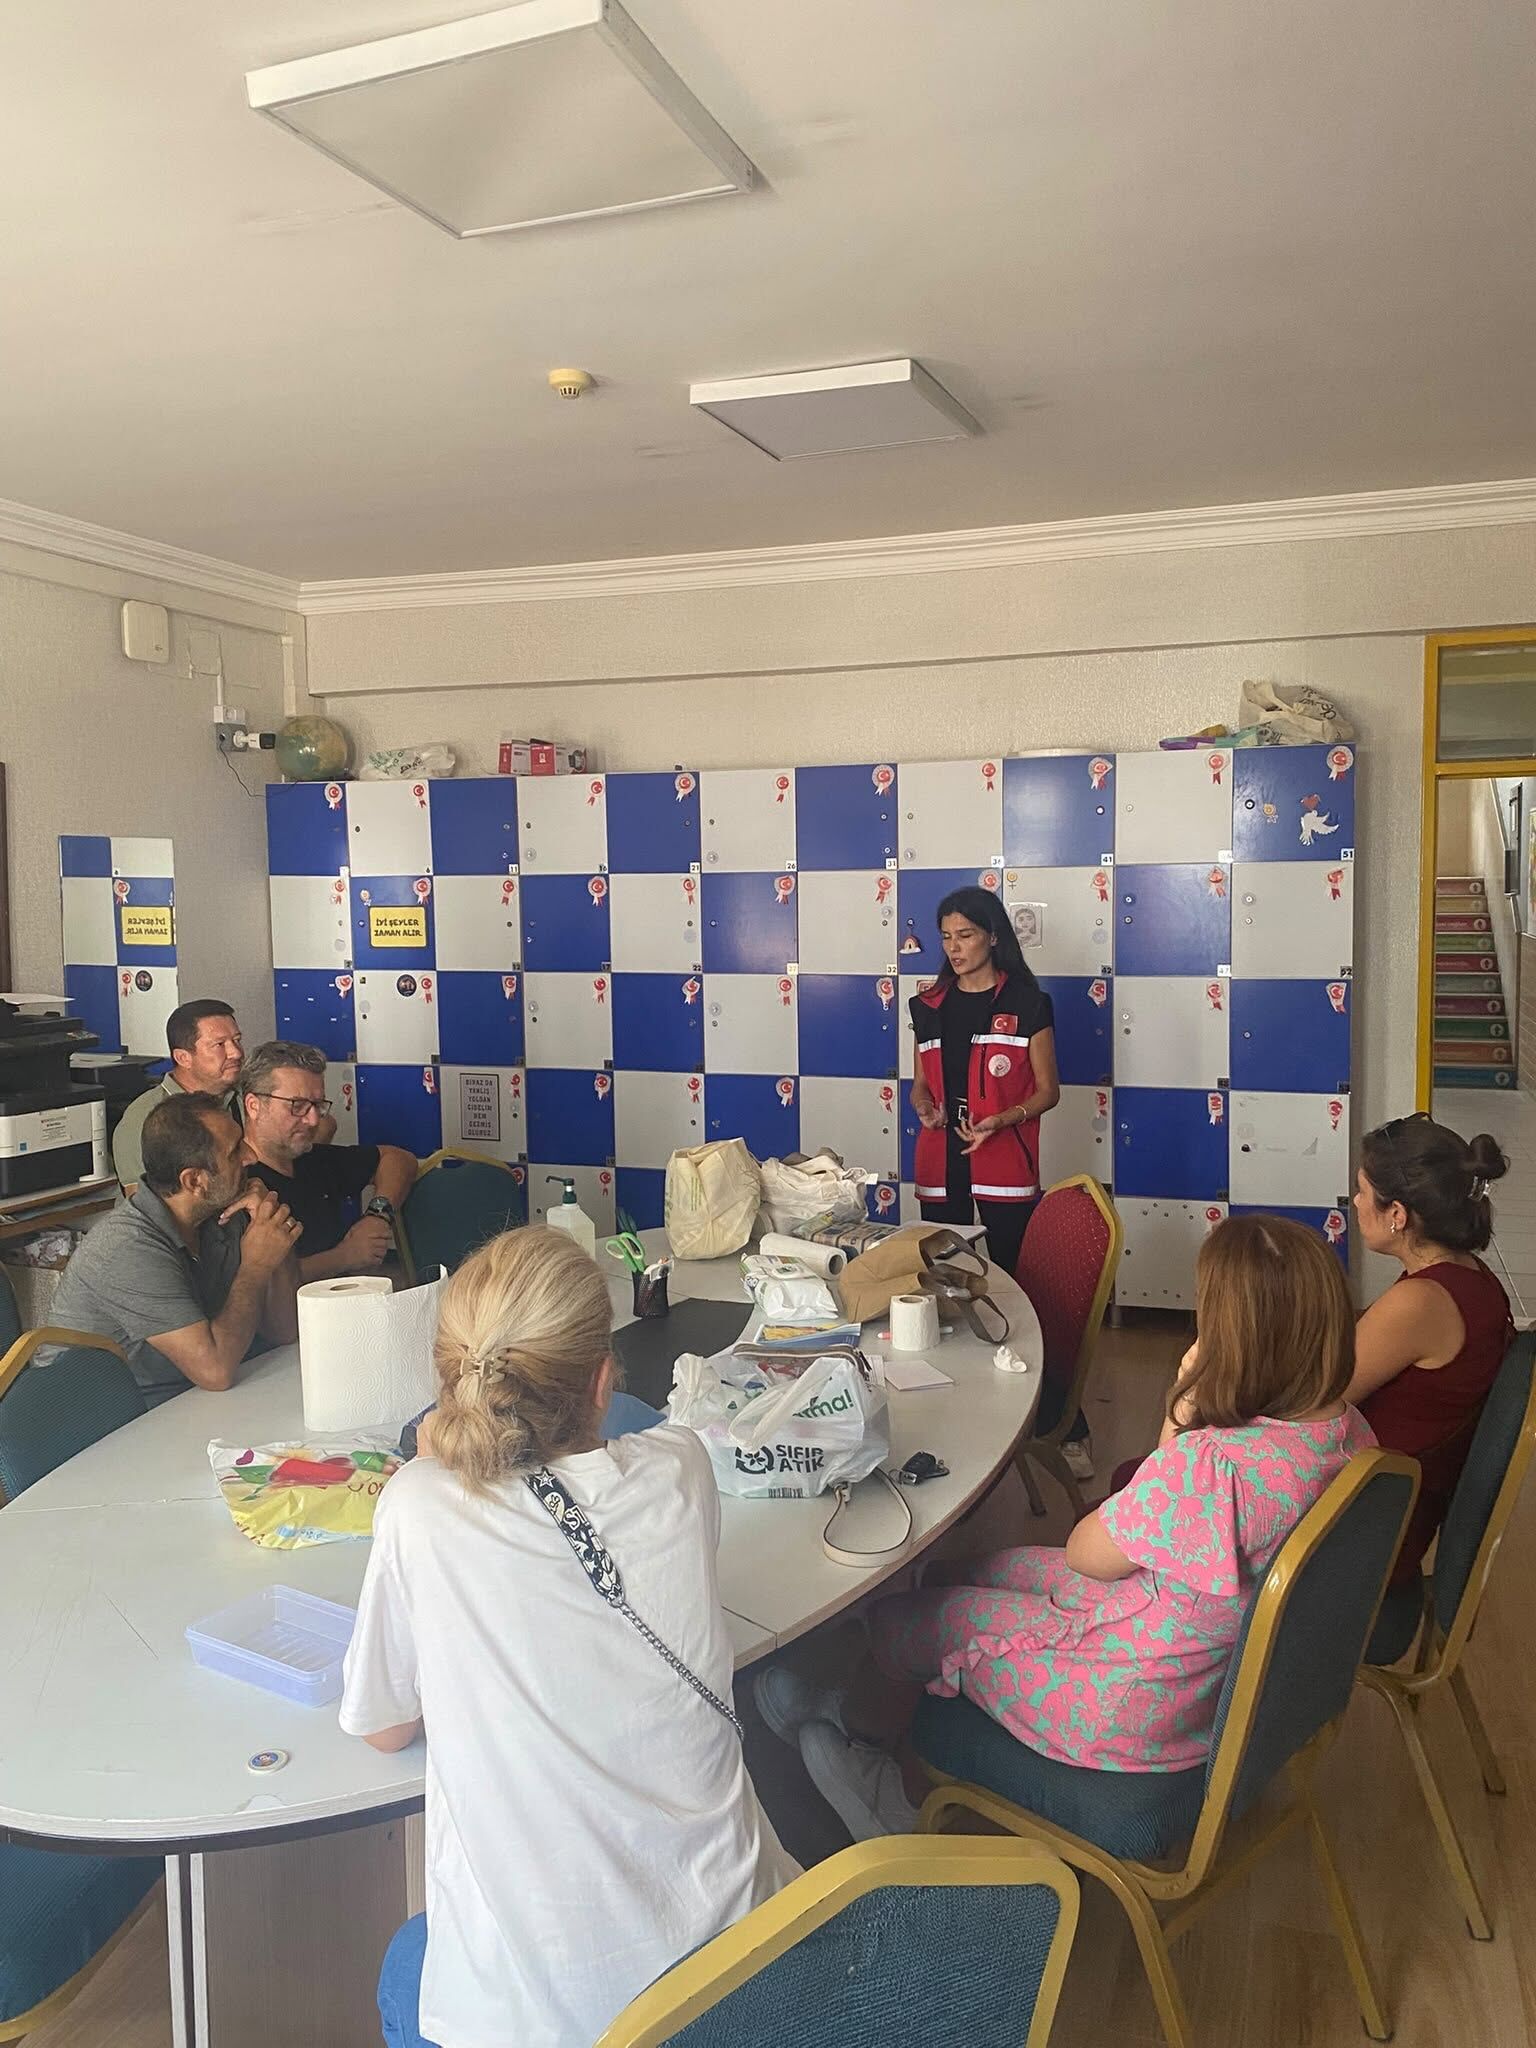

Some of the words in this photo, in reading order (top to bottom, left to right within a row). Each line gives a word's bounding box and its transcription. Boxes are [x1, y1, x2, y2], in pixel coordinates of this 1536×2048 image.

[1342, 850, 1353, 859] 51
[389, 918, 419, 927] ŞEYLER
[374, 929, 401, 937] ZAMAN
[693, 964, 701, 972] 22
[1101, 966, 1112, 974] 42
[775, 1444, 825, 1459] SIFIR
[779, 1456, 825, 1473] ATIK
